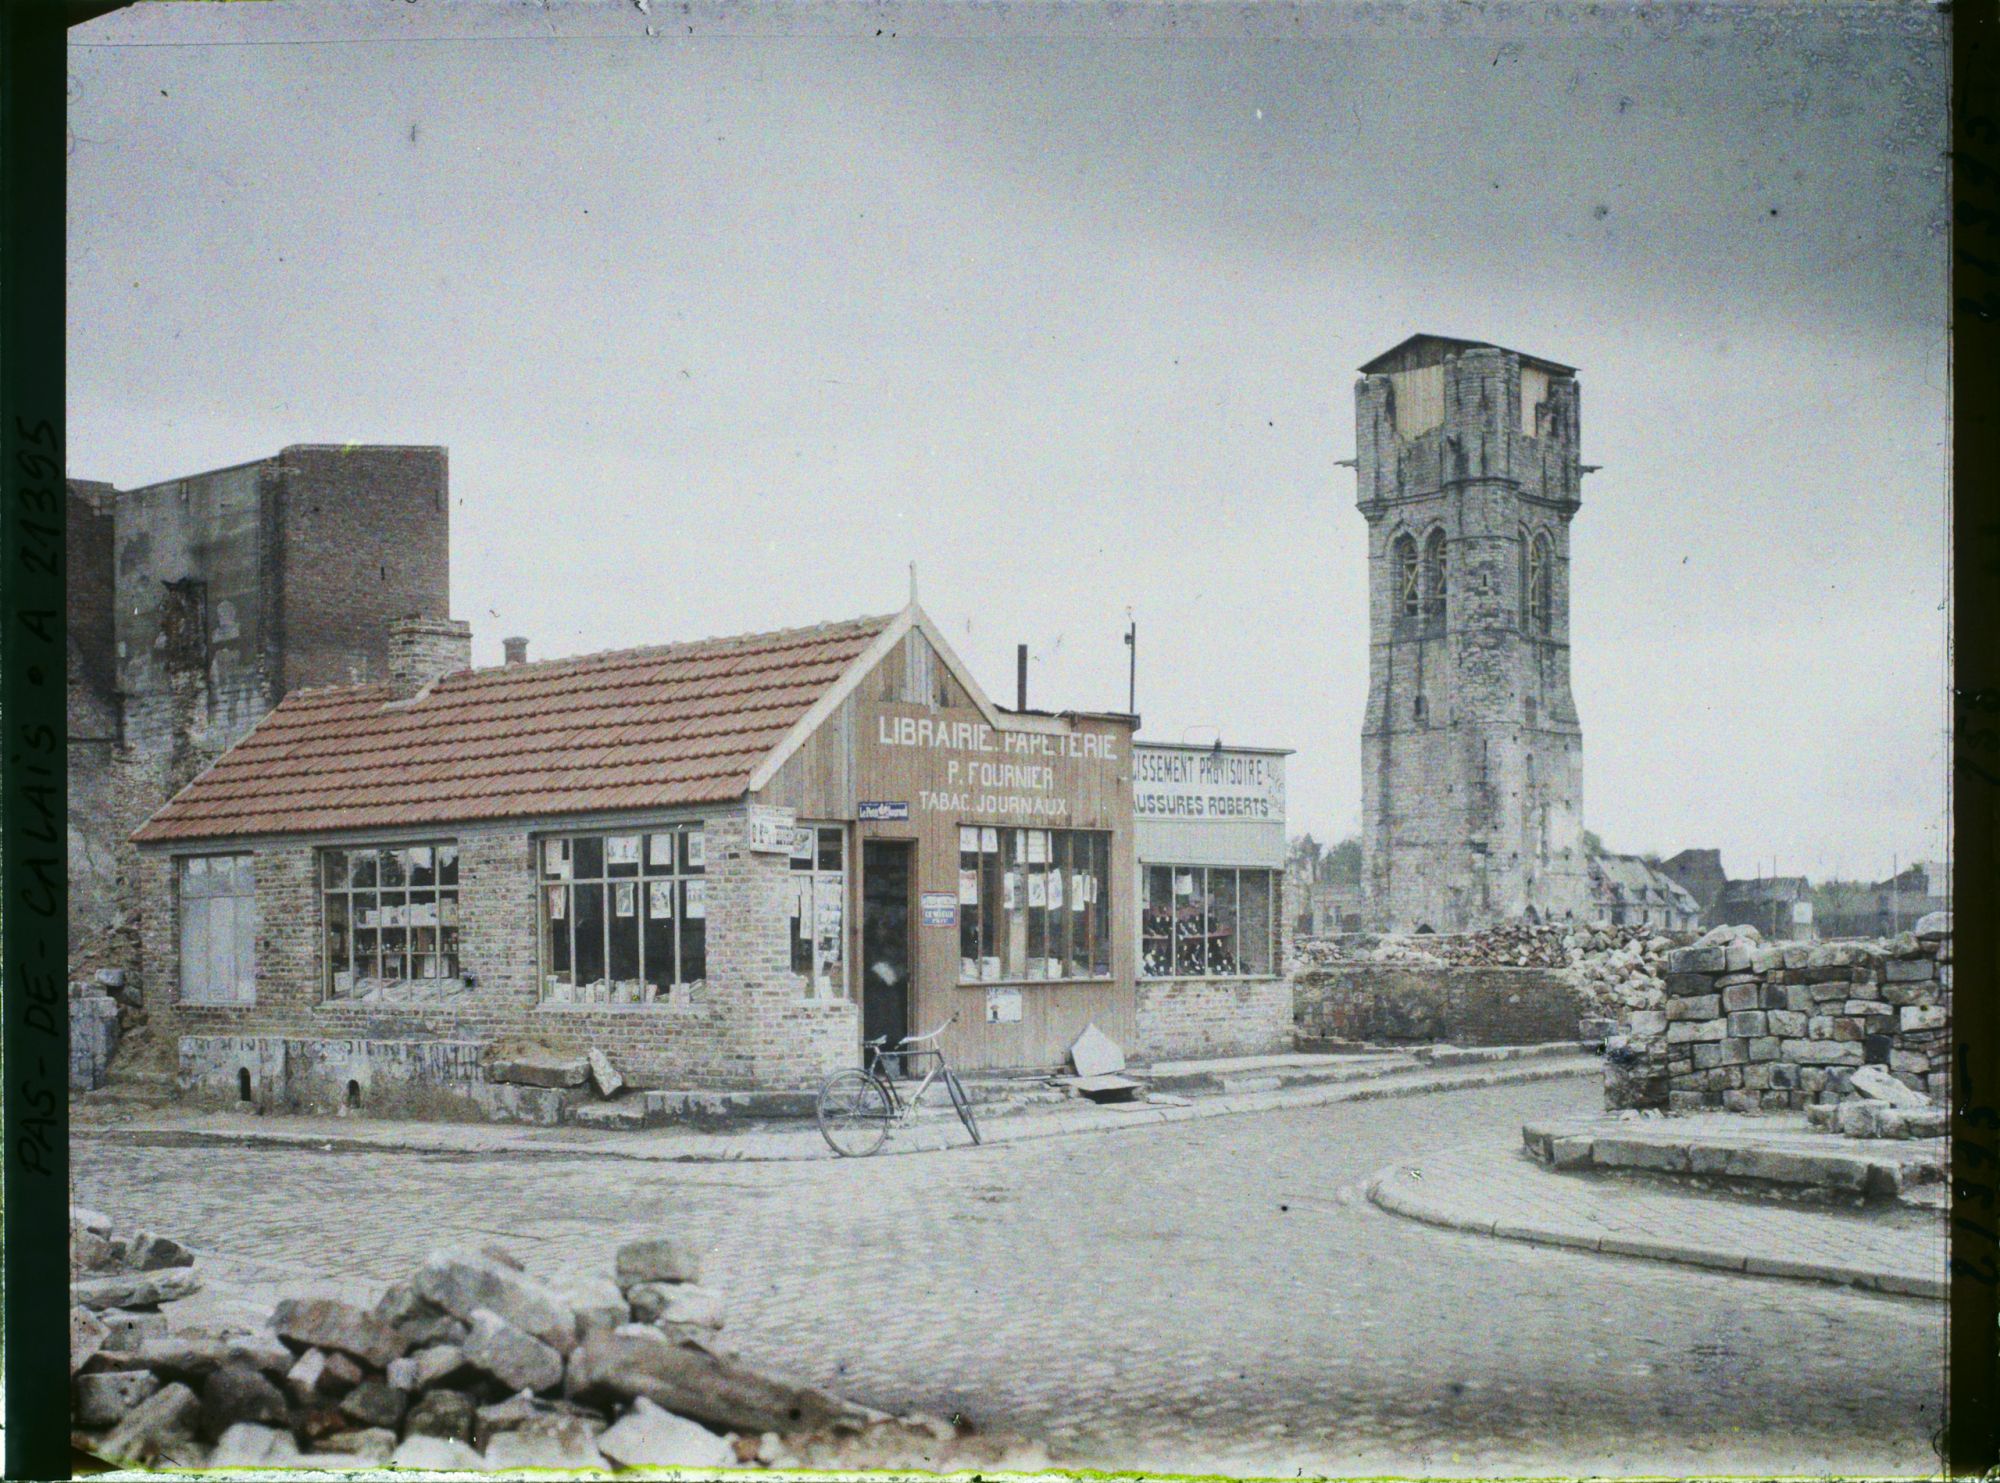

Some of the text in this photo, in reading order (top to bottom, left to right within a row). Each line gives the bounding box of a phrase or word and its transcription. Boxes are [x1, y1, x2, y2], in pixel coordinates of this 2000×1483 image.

[15, 414, 61, 578] 21395
[16, 608, 58, 644] A
[968, 761, 1054, 790] FOURNIER
[1200, 756, 1263, 786] PROVISOIRE
[976, 794, 1068, 816] JOURNAUX
[1209, 796, 1269, 818] ROBERTS
